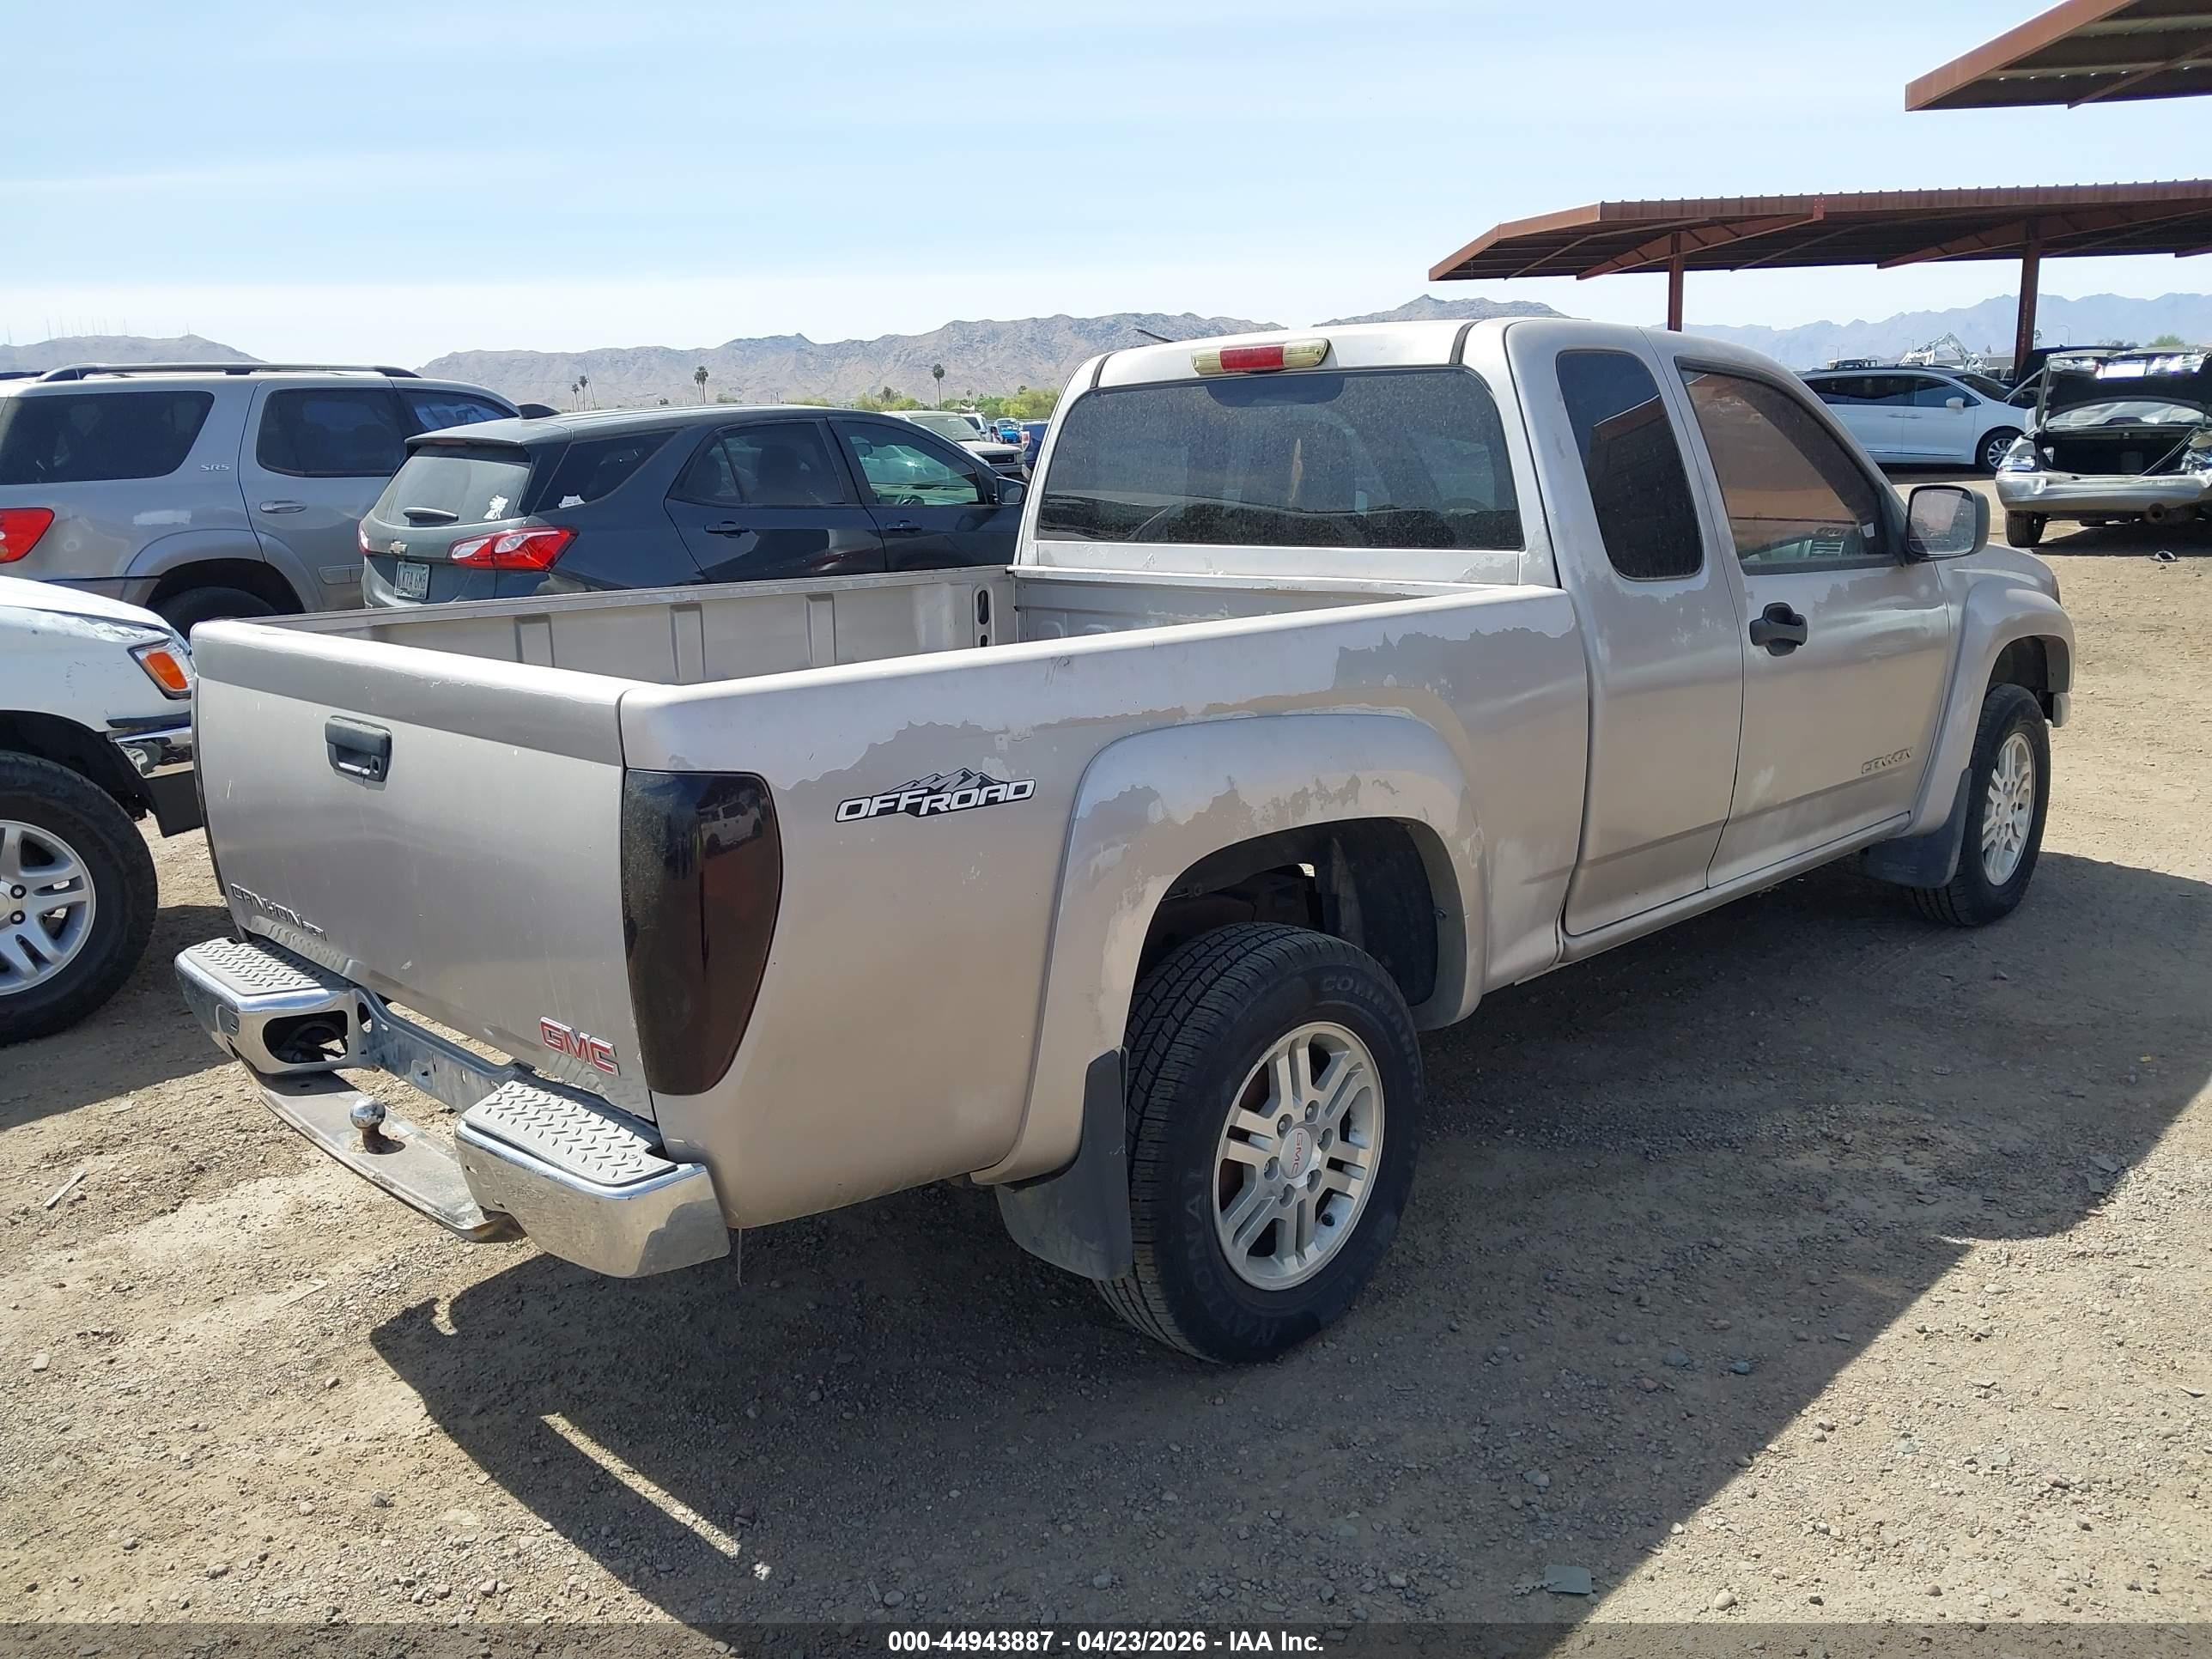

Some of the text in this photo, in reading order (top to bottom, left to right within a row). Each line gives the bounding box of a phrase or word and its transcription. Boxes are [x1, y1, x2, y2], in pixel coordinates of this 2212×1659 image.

[836, 780, 1036, 822] OFFROAD
[231, 883, 303, 929] CANYON
[539, 1016, 621, 1077] GMC
[1291, 1132, 1303, 1176] GMC
